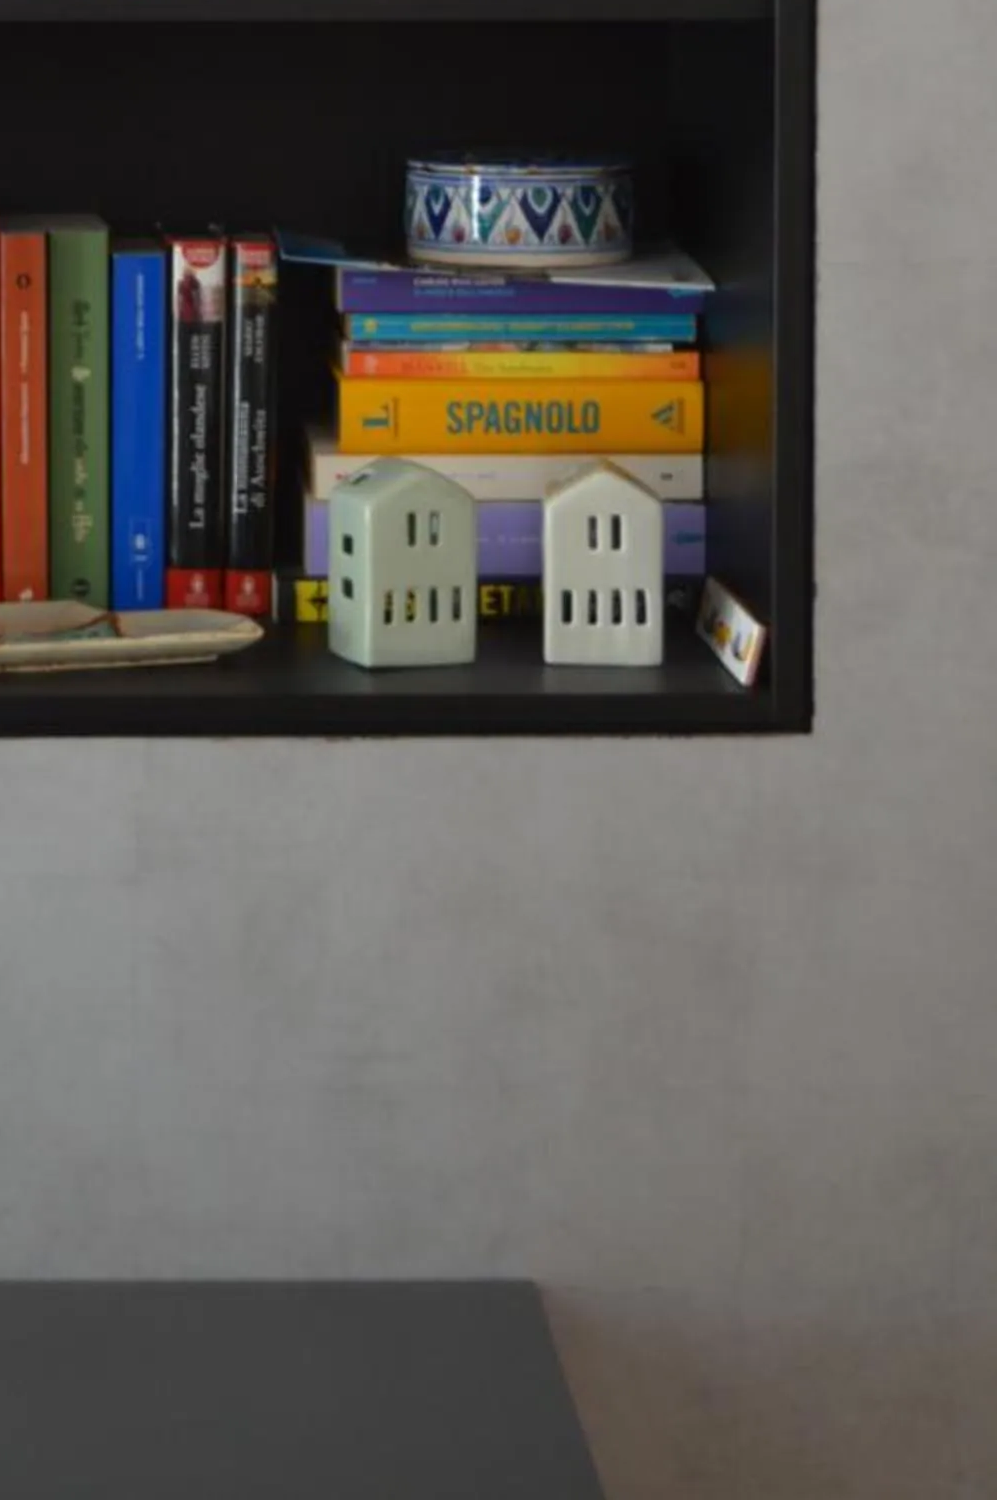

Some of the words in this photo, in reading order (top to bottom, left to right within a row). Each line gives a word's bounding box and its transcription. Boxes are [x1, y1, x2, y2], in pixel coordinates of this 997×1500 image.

[188, 382, 207, 449] olandese
[445, 400, 601, 434] SPAGNOLO
[189, 451, 209, 504] moglie
[188, 506, 205, 529] La
